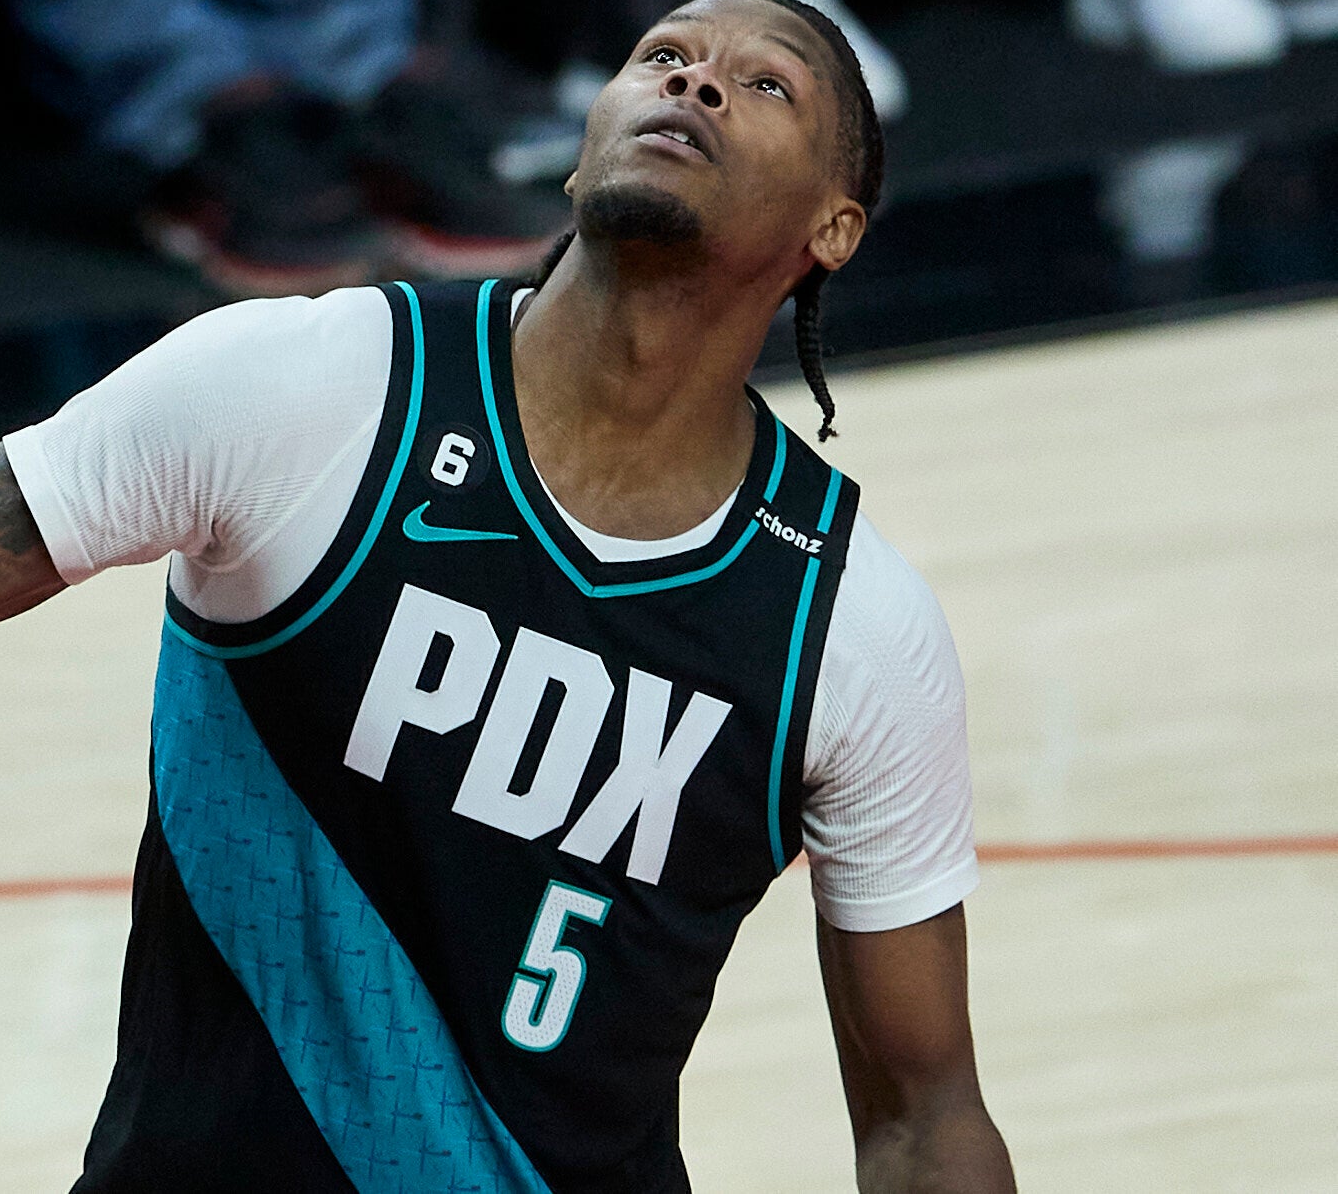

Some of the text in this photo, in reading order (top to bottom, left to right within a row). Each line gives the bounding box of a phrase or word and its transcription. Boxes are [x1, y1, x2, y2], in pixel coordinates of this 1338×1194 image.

[430, 432, 475, 486] 6
[343, 583, 733, 886] PDX
[501, 879, 614, 1053] 5
